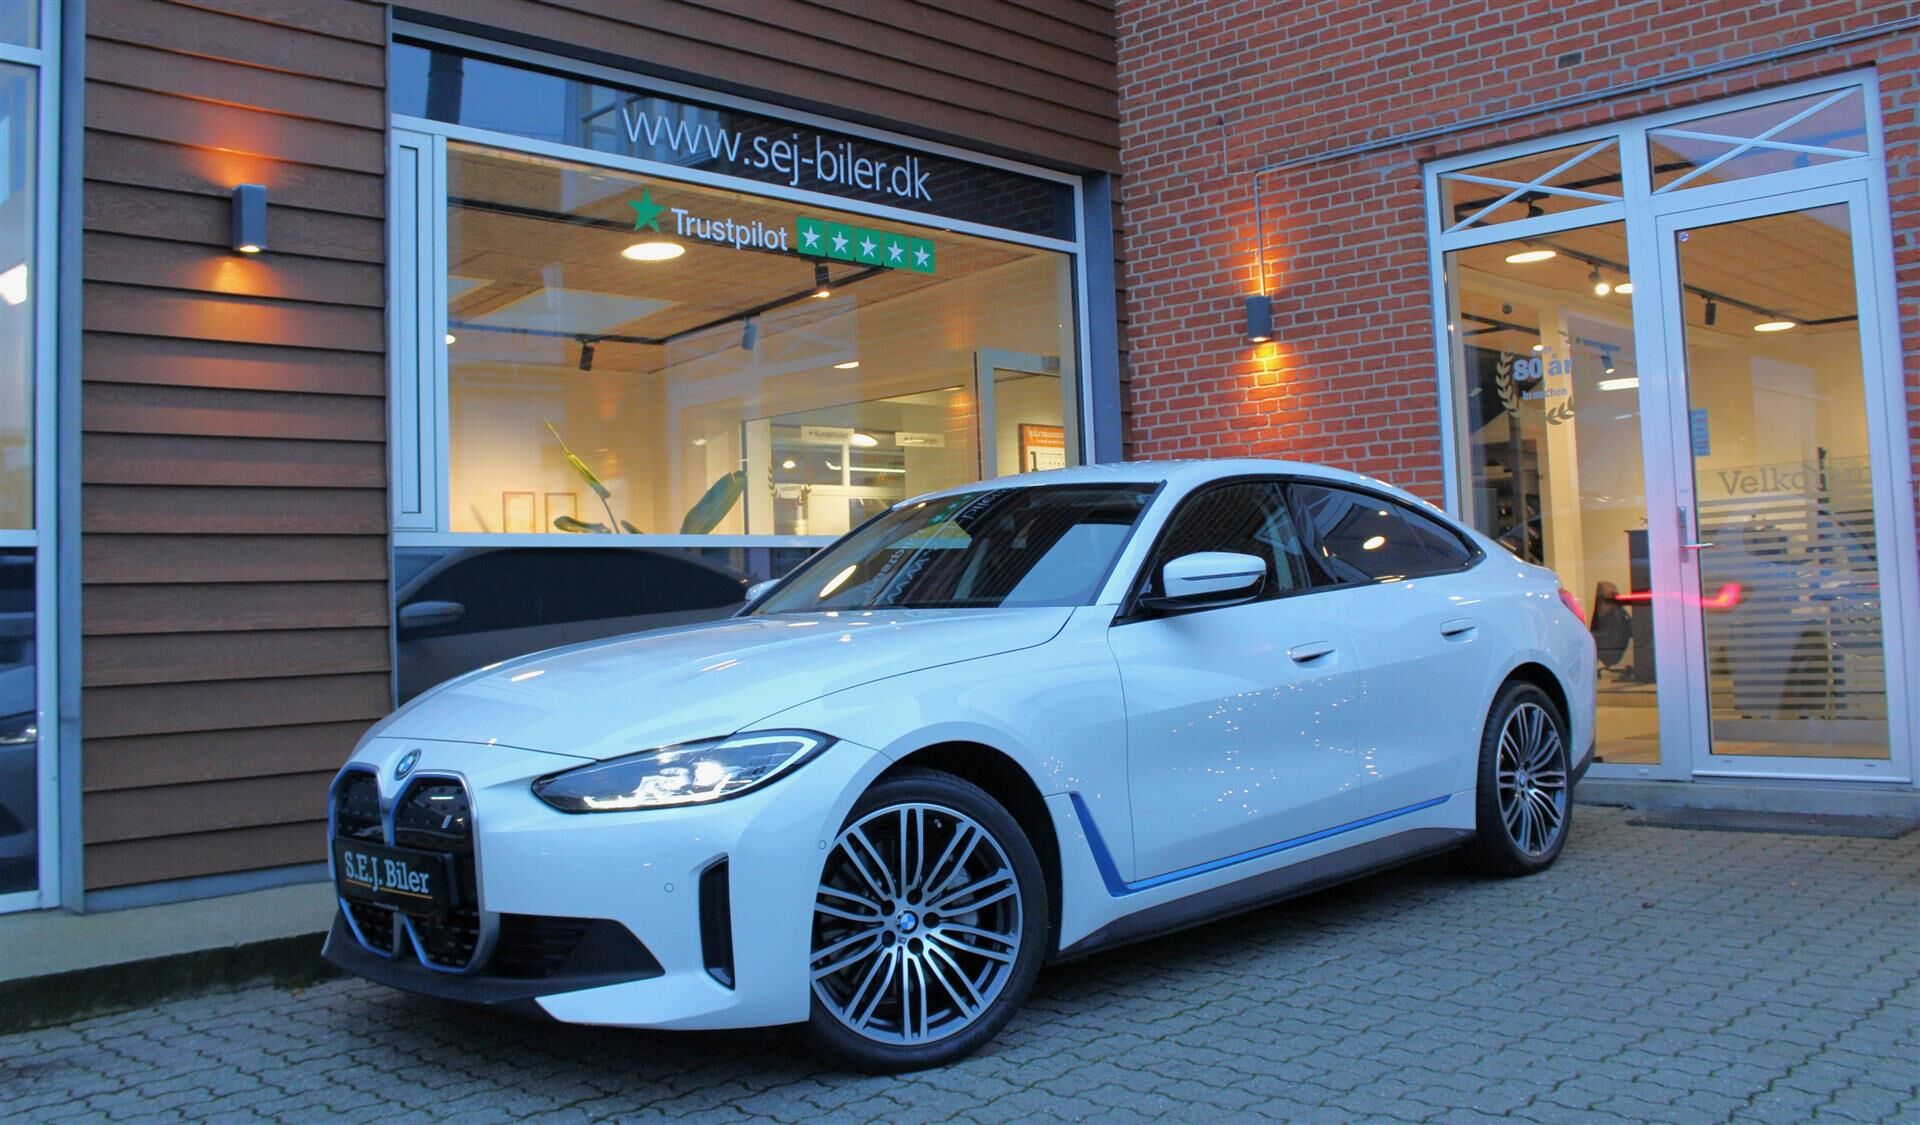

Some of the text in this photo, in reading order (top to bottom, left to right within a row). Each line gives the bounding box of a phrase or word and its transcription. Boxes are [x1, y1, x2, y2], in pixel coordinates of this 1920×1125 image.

[623, 108, 932, 200] www.sej-biler.dk
[671, 208, 788, 251] Trustpilot
[1513, 357, 1543, 381] 80
[344, 850, 430, 894] S.E.J. Biler
